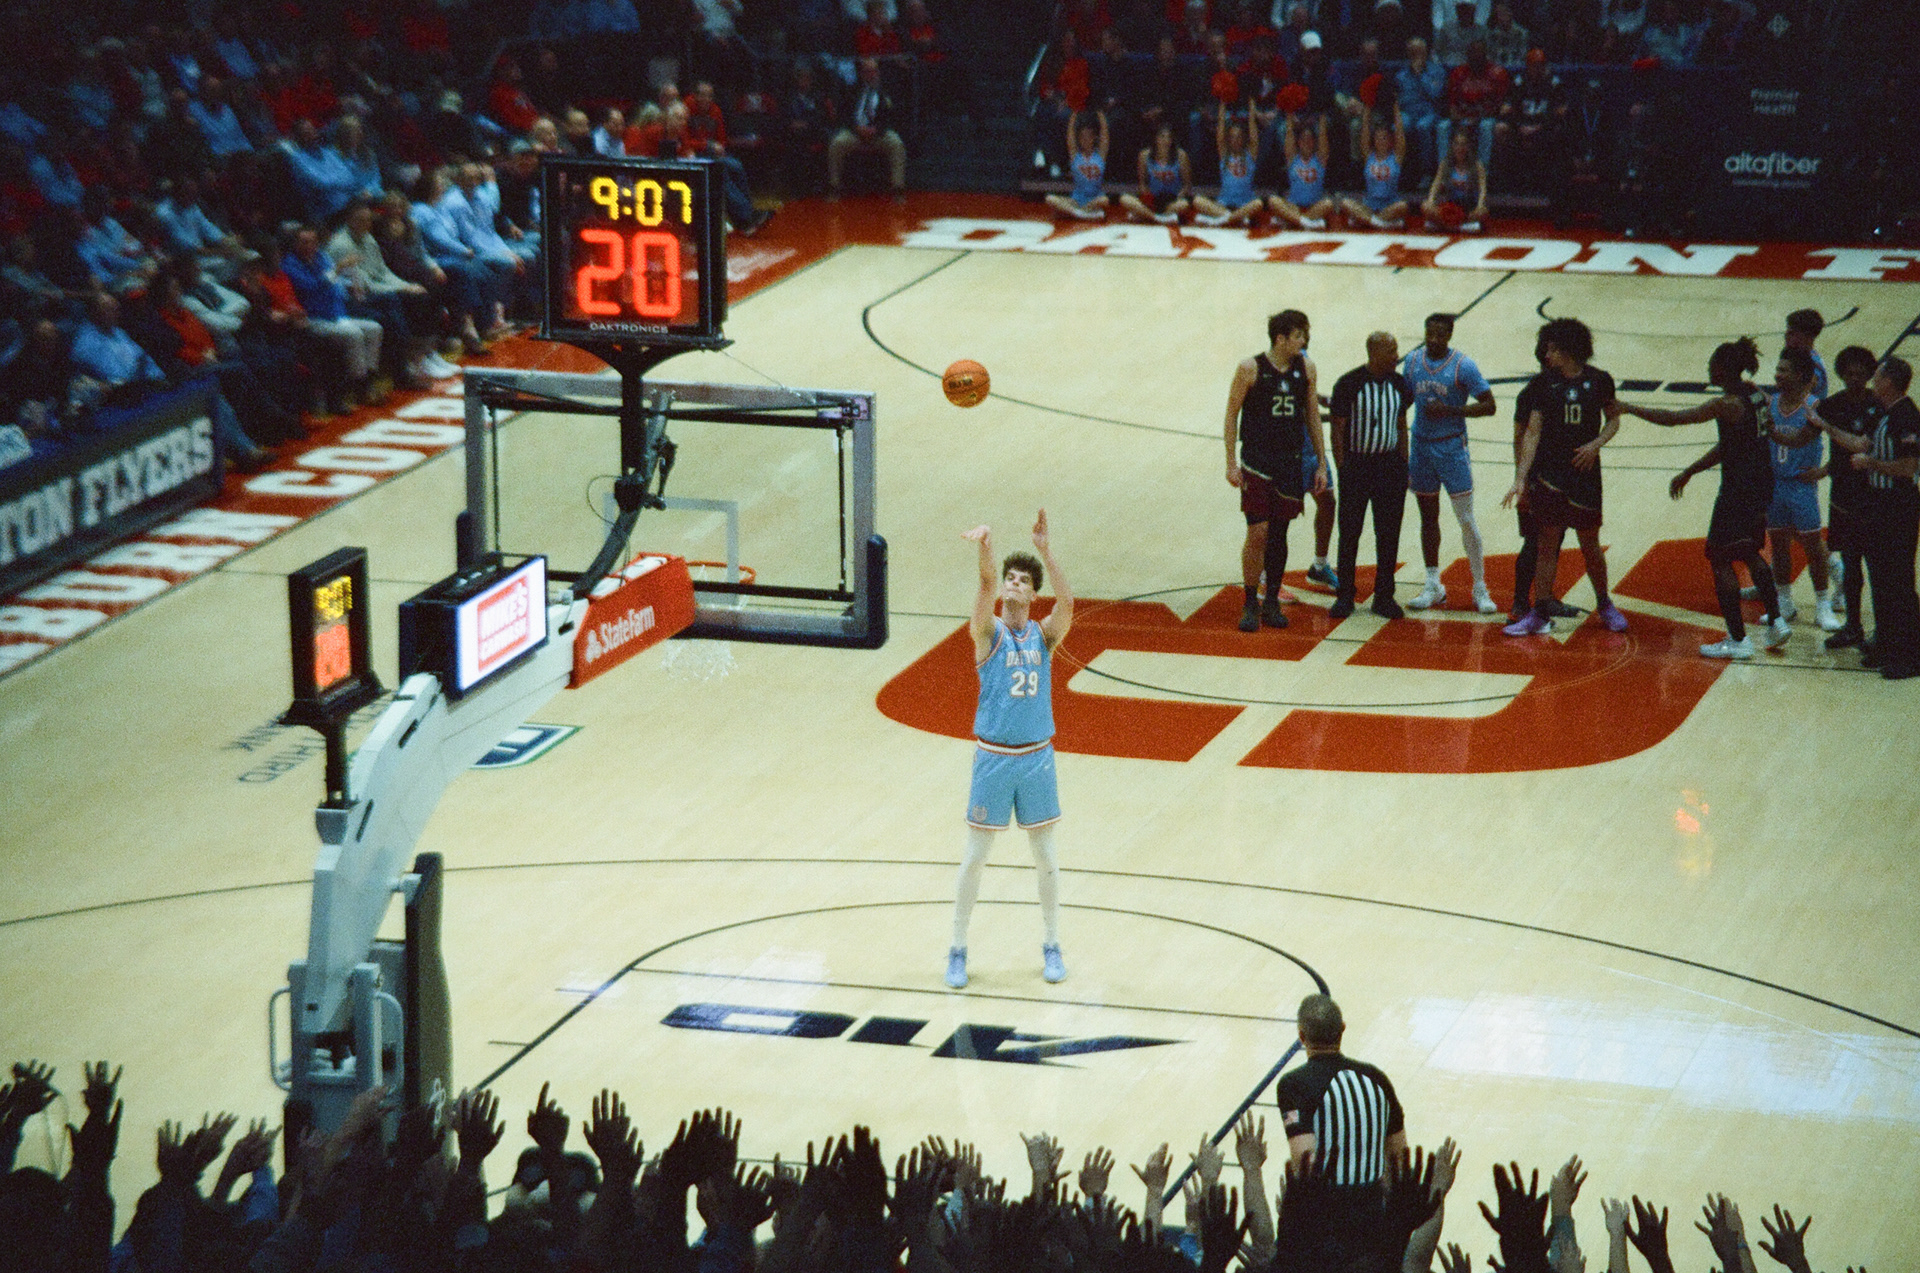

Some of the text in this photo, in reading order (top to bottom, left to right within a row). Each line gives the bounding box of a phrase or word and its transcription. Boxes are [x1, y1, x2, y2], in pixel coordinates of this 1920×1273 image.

[1724, 152, 1820, 177] altafiber
[589, 176, 693, 227] 9:07
[901, 217, 1760, 277] DAYTON
[577, 229, 682, 317] 20
[589, 322, 669, 334] DAKTRONICS
[1272, 396, 1295, 416] 25
[1564, 404, 1582, 423] 10
[1777, 445, 1788, 463] 0
[80, 416, 214, 527] FLYERS
[1011, 670, 1039, 697] 29
